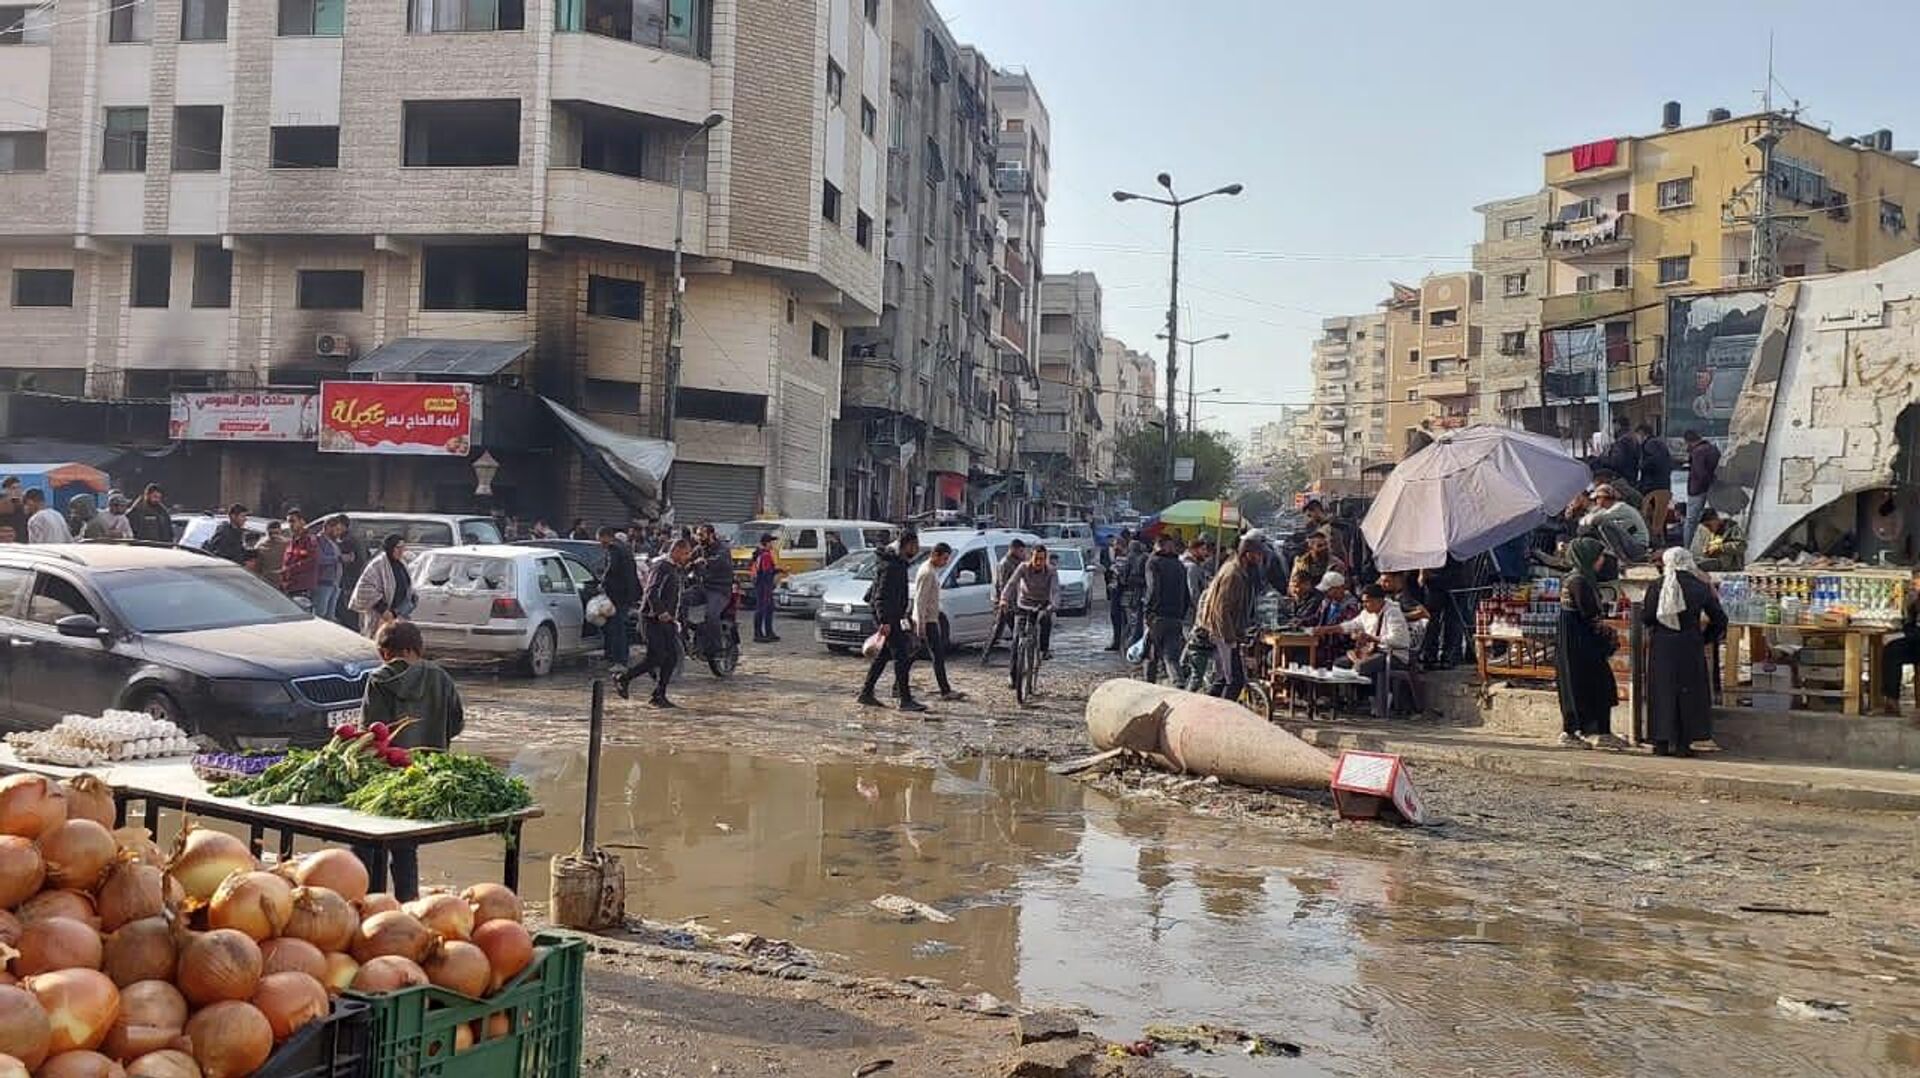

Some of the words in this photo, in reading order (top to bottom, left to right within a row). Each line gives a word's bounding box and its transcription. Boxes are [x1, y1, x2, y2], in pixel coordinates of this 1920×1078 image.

[262, 394, 295, 406] محلات
[331, 397, 385, 428] عكيلة
[435, 413, 460, 427] أبناء
[405, 413, 435, 429] الحاج
